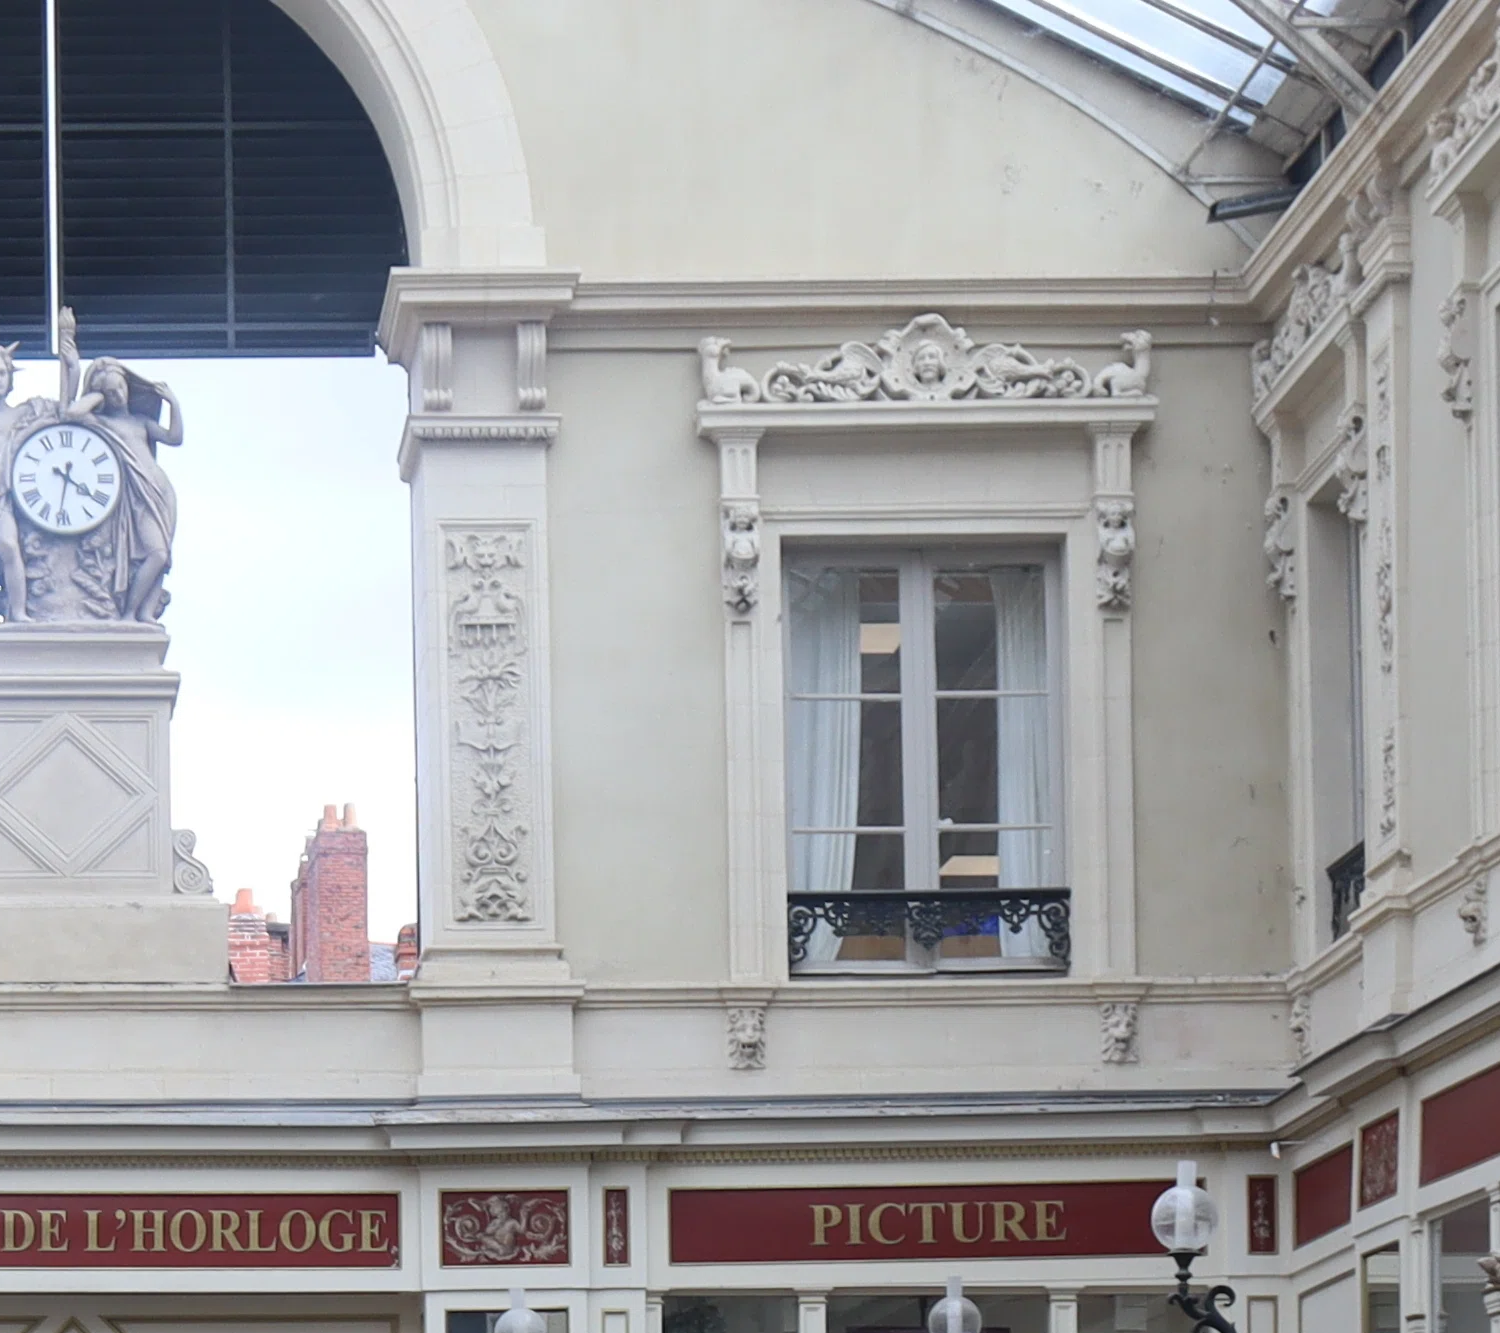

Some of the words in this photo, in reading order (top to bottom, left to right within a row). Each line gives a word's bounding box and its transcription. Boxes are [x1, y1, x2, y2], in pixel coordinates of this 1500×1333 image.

[0, 1210, 70, 1252] DE
[83, 1208, 390, 1253] L'HORLOGE
[808, 1200, 1067, 1246] PICTURE
